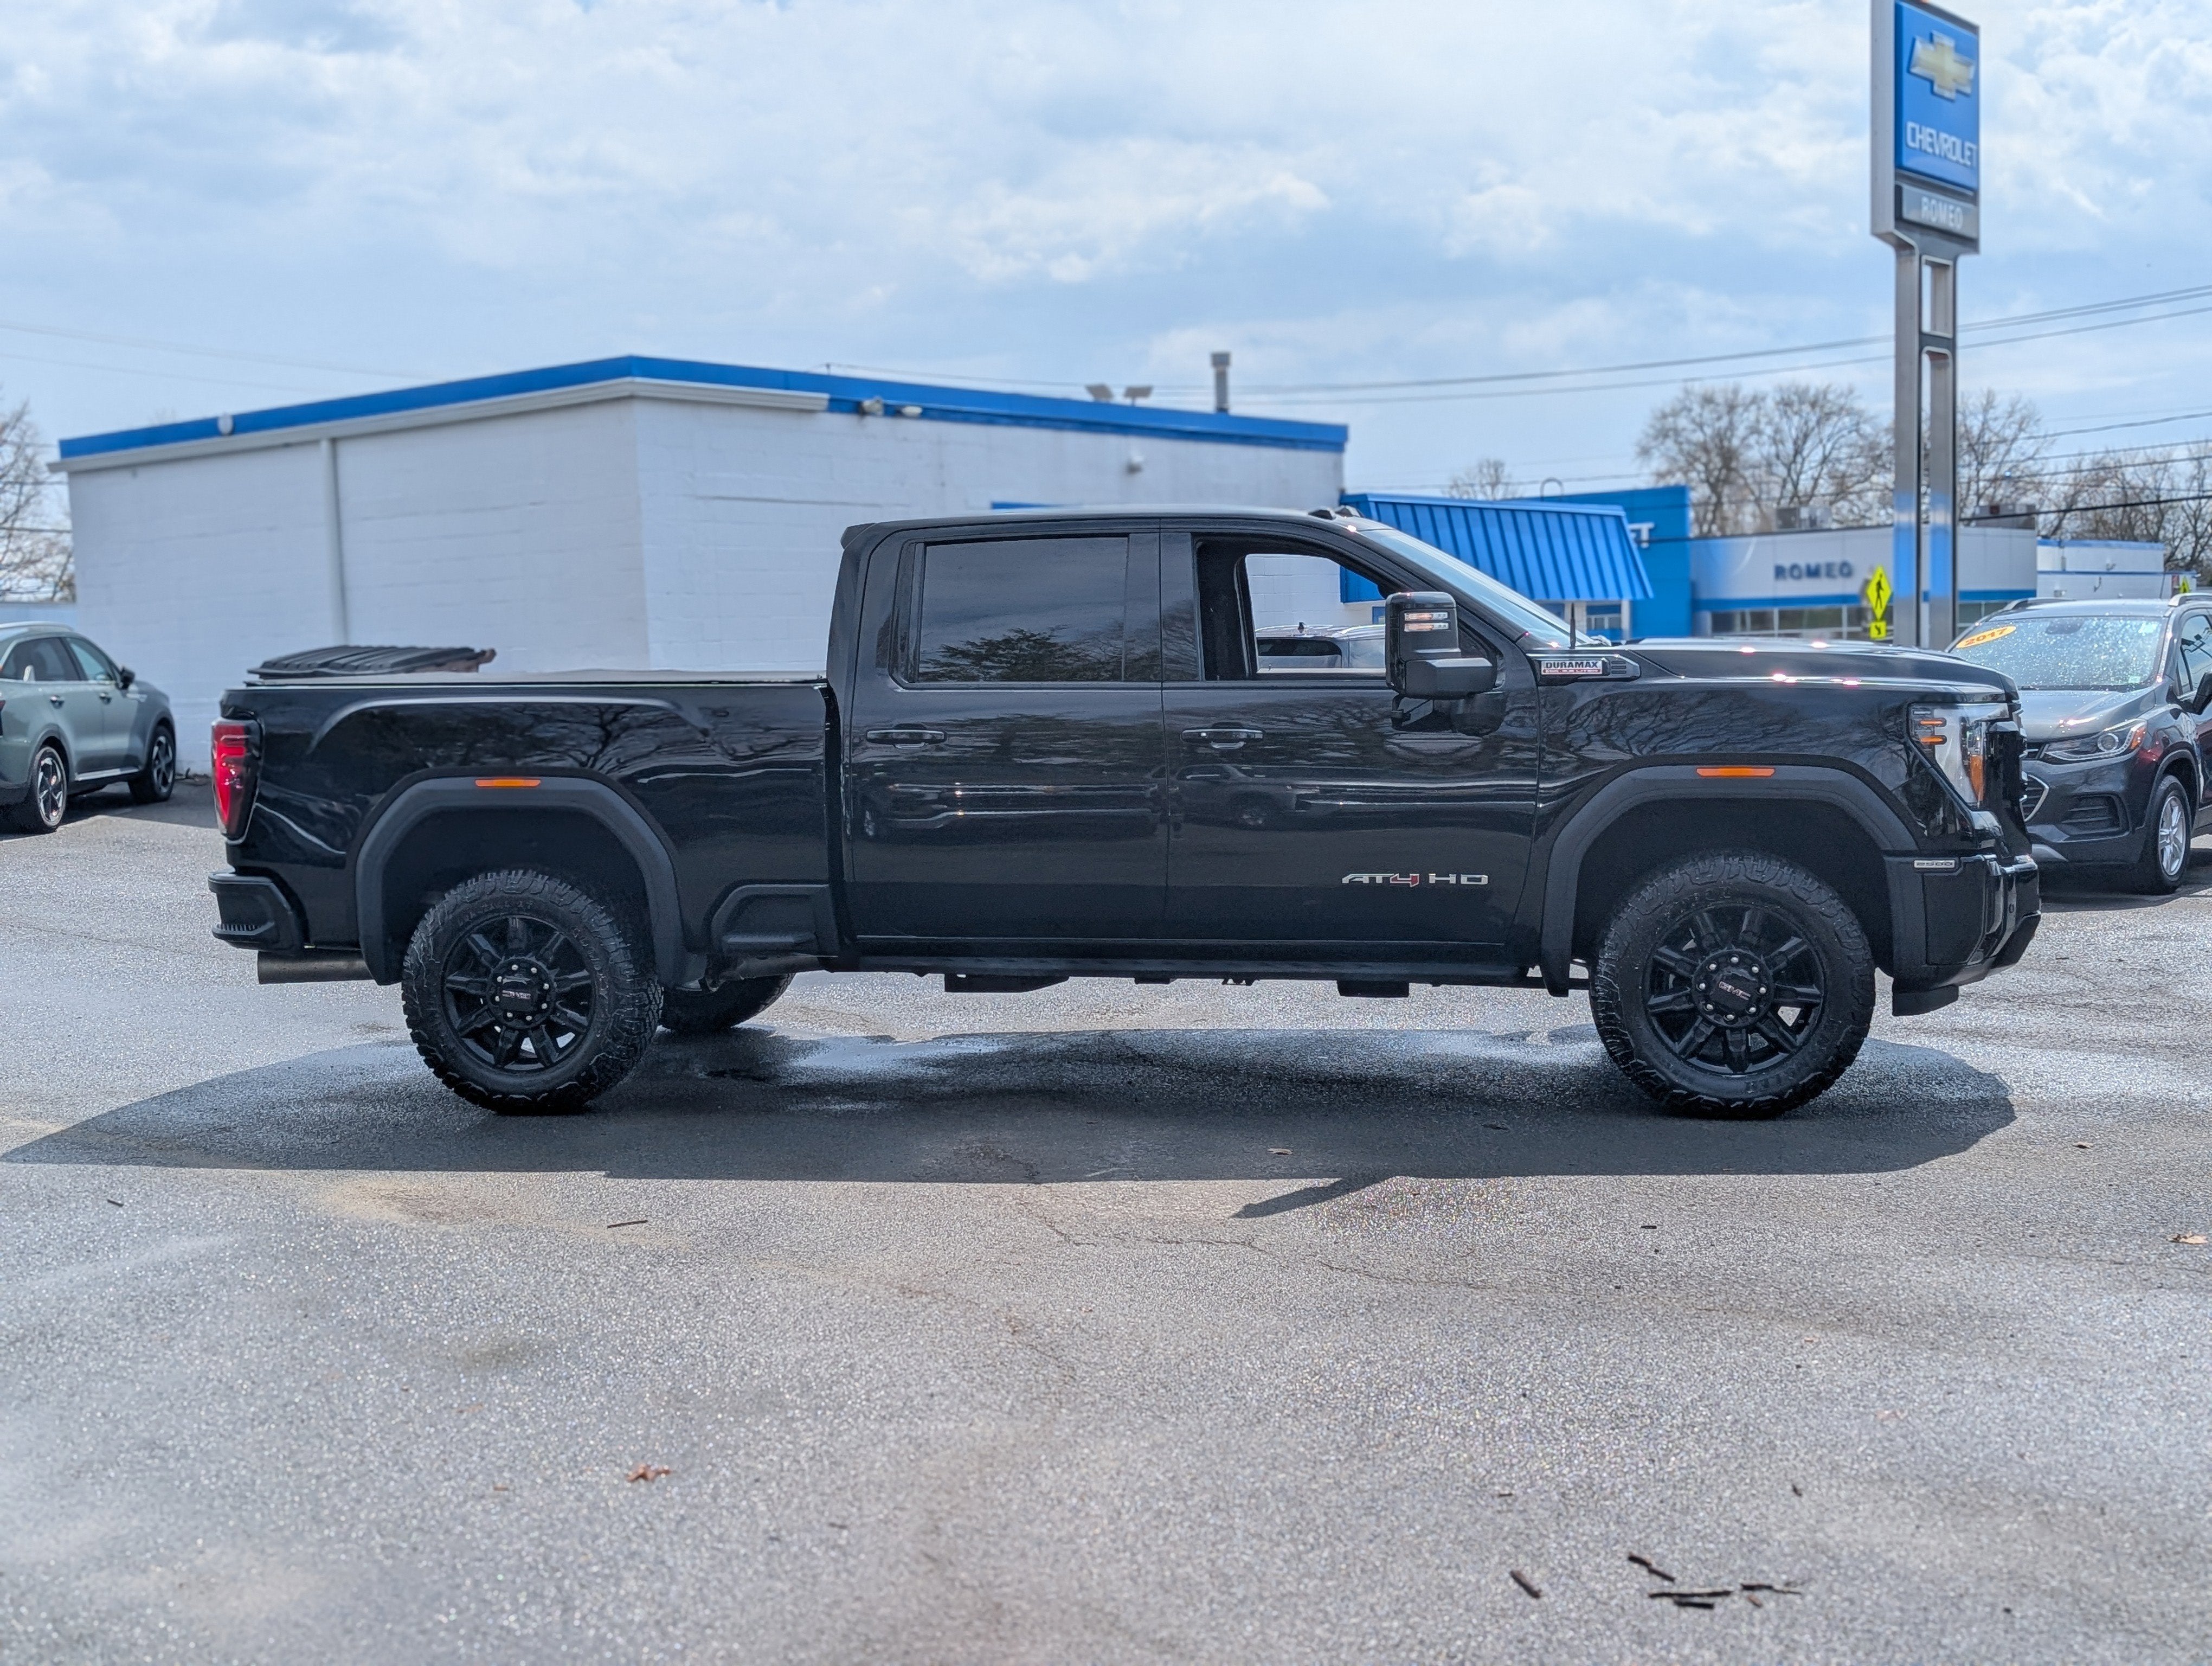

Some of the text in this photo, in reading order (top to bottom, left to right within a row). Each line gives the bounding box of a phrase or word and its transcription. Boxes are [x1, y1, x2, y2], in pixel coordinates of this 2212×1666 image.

[1906, 121, 1978, 166] CHEVROLET
[1921, 196, 1963, 230] ROMEO
[1774, 560, 1854, 580] ROMEO
[1964, 627, 2008, 646] 2017
[1342, 874, 1488, 887] AT4 HD
[1719, 981, 1751, 1001] GMC
